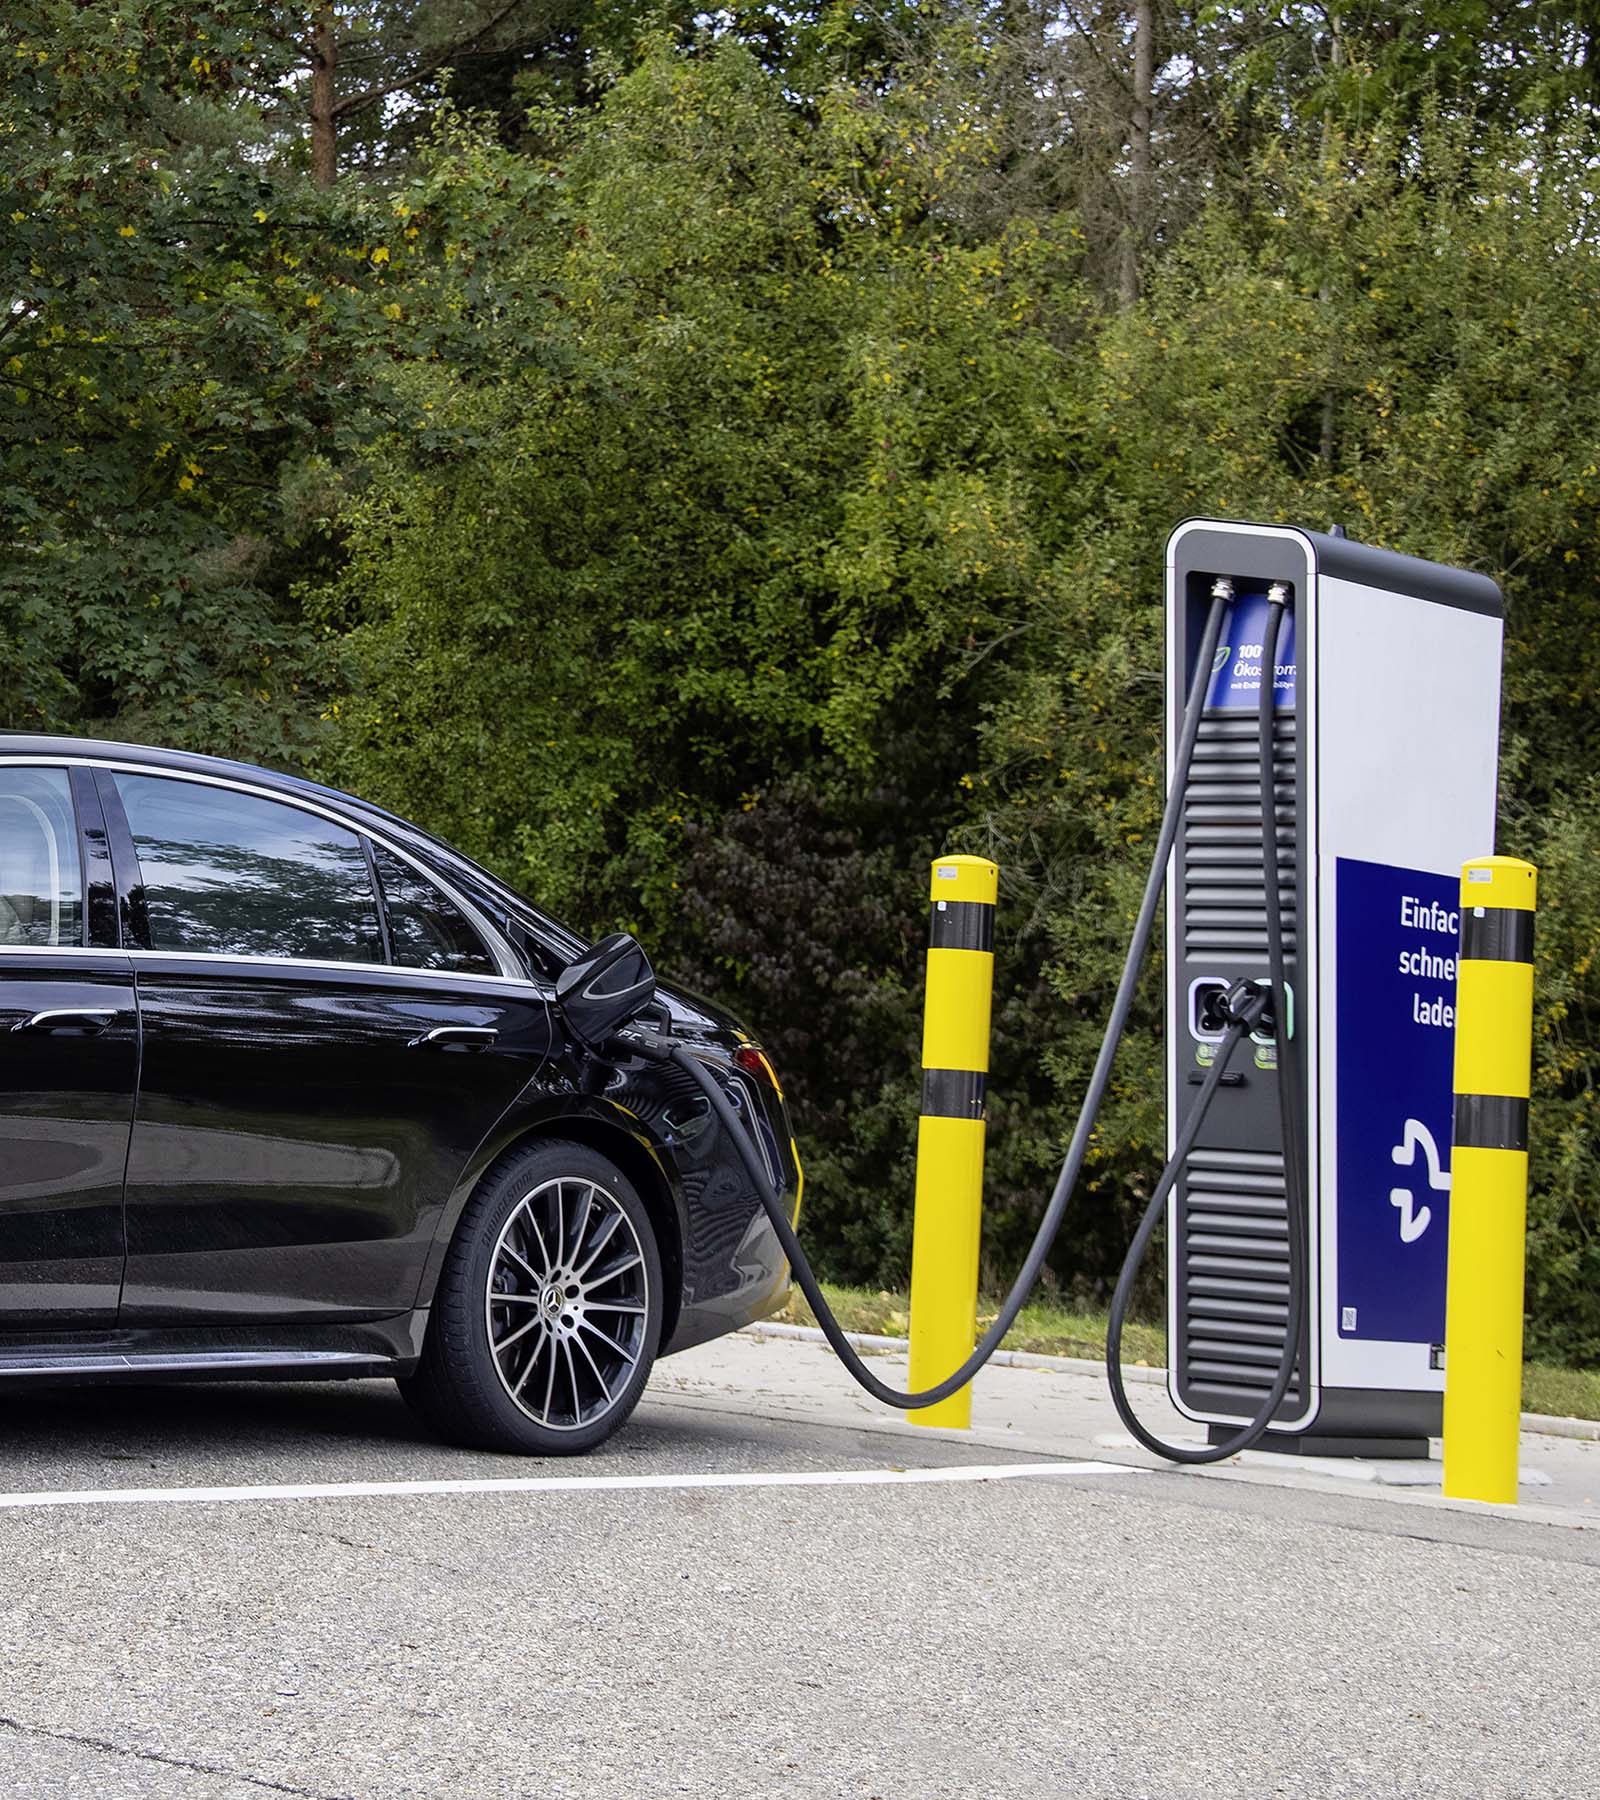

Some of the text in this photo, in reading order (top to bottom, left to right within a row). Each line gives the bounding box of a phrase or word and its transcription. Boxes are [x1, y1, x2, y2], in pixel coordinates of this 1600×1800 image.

[1238, 645, 1263, 658] 100
[1401, 896, 1459, 934] Einfac
[1398, 946, 1460, 981] schnel
[1413, 993, 1456, 1028] lade
[616, 1029, 642, 1041] PC
